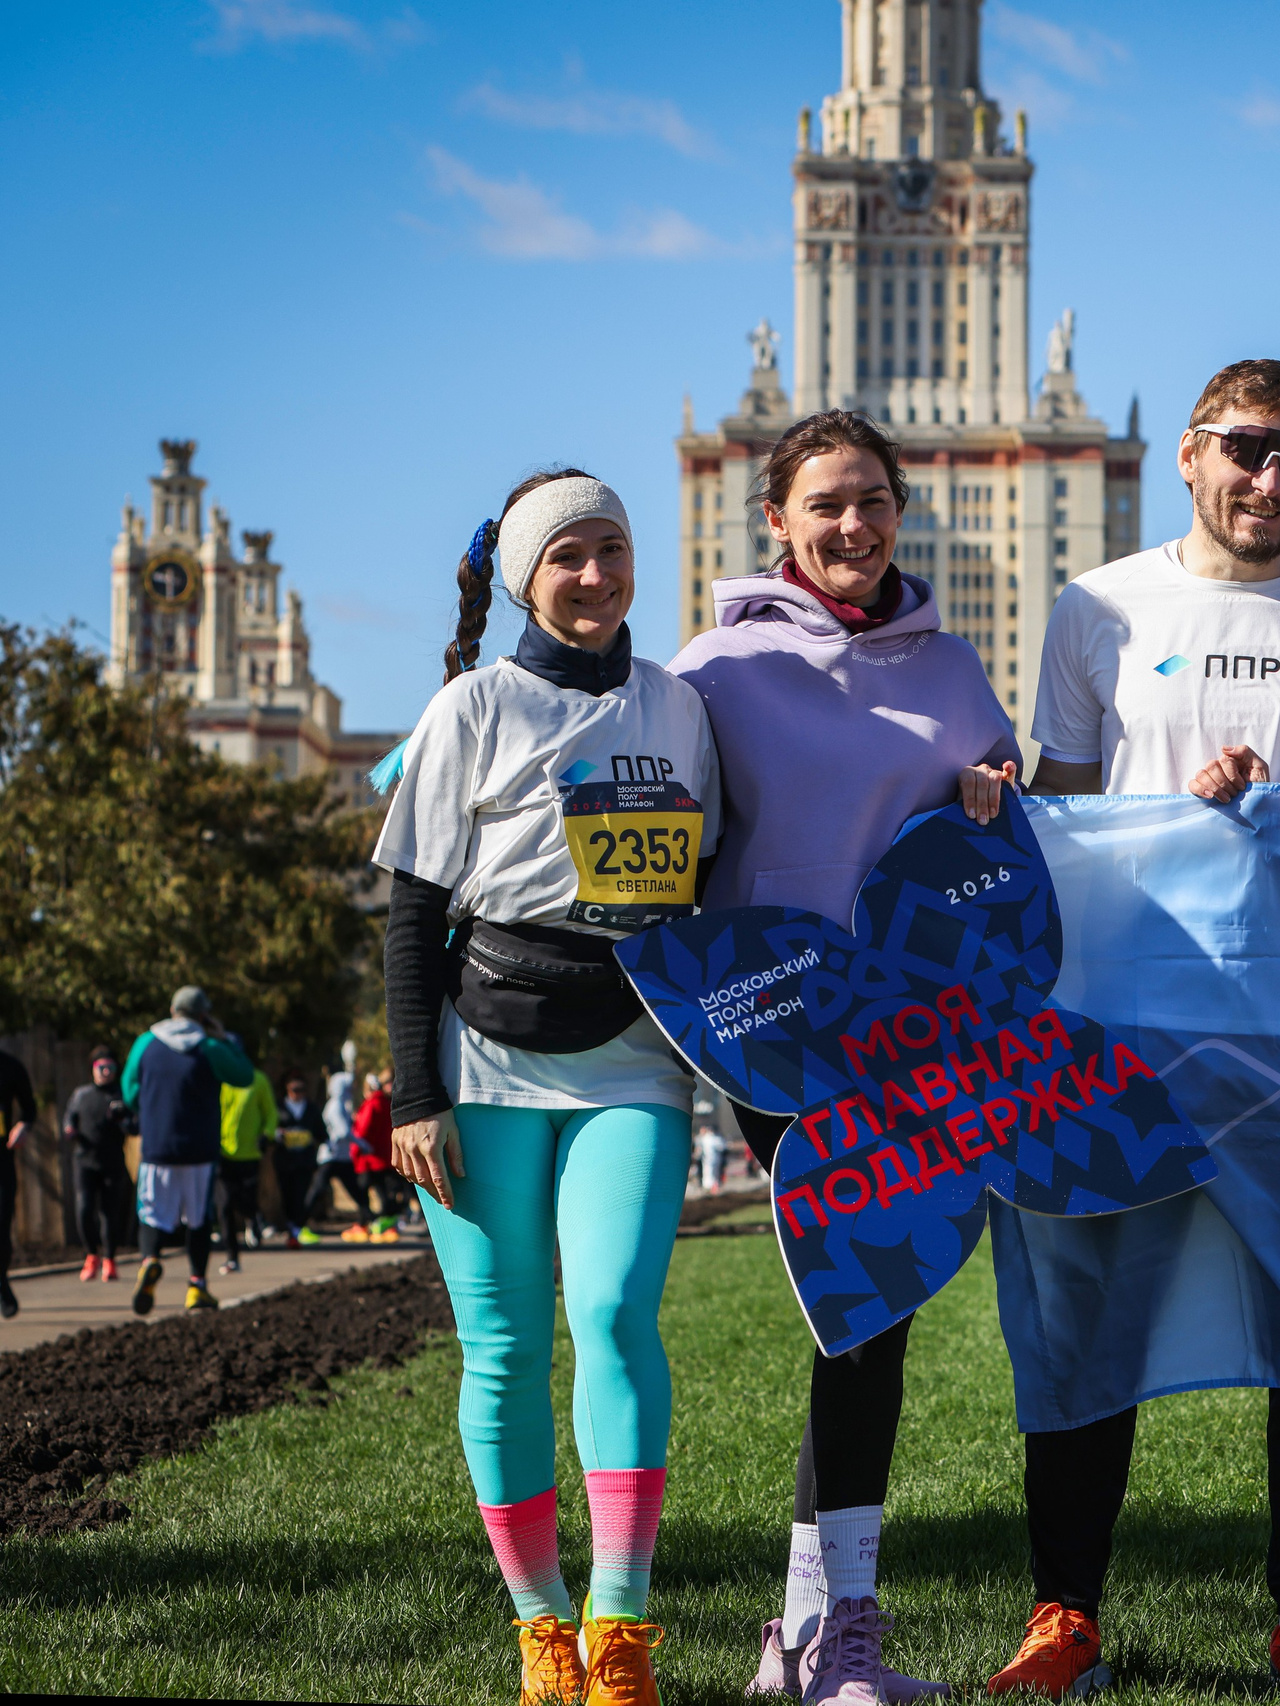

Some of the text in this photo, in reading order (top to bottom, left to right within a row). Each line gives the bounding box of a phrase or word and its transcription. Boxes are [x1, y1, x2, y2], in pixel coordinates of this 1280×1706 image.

[851, 652, 887, 666] БОЛЬШЕ
[1204, 654, 1280, 680] ППР
[610, 755, 674, 781] ППР
[572, 800, 612, 812] 2026
[617, 784, 665, 794] МОСКОВСКИЙ
[589, 828, 690, 874] 2353
[616, 879, 677, 893] СВЕТЛАНА
[945, 866, 1011, 905] 2026
[698, 948, 820, 1012] МОСКОВСКИЙ
[707, 996, 756, 1028] ПОЛУ
[715, 996, 805, 1044] МАРАФОН
[838, 983, 983, 1077] МОЯ
[800, 1007, 1074, 1161] ГЛАВНАЯ
[776, 1042, 1157, 1239] ПОДДЕРЖКА
